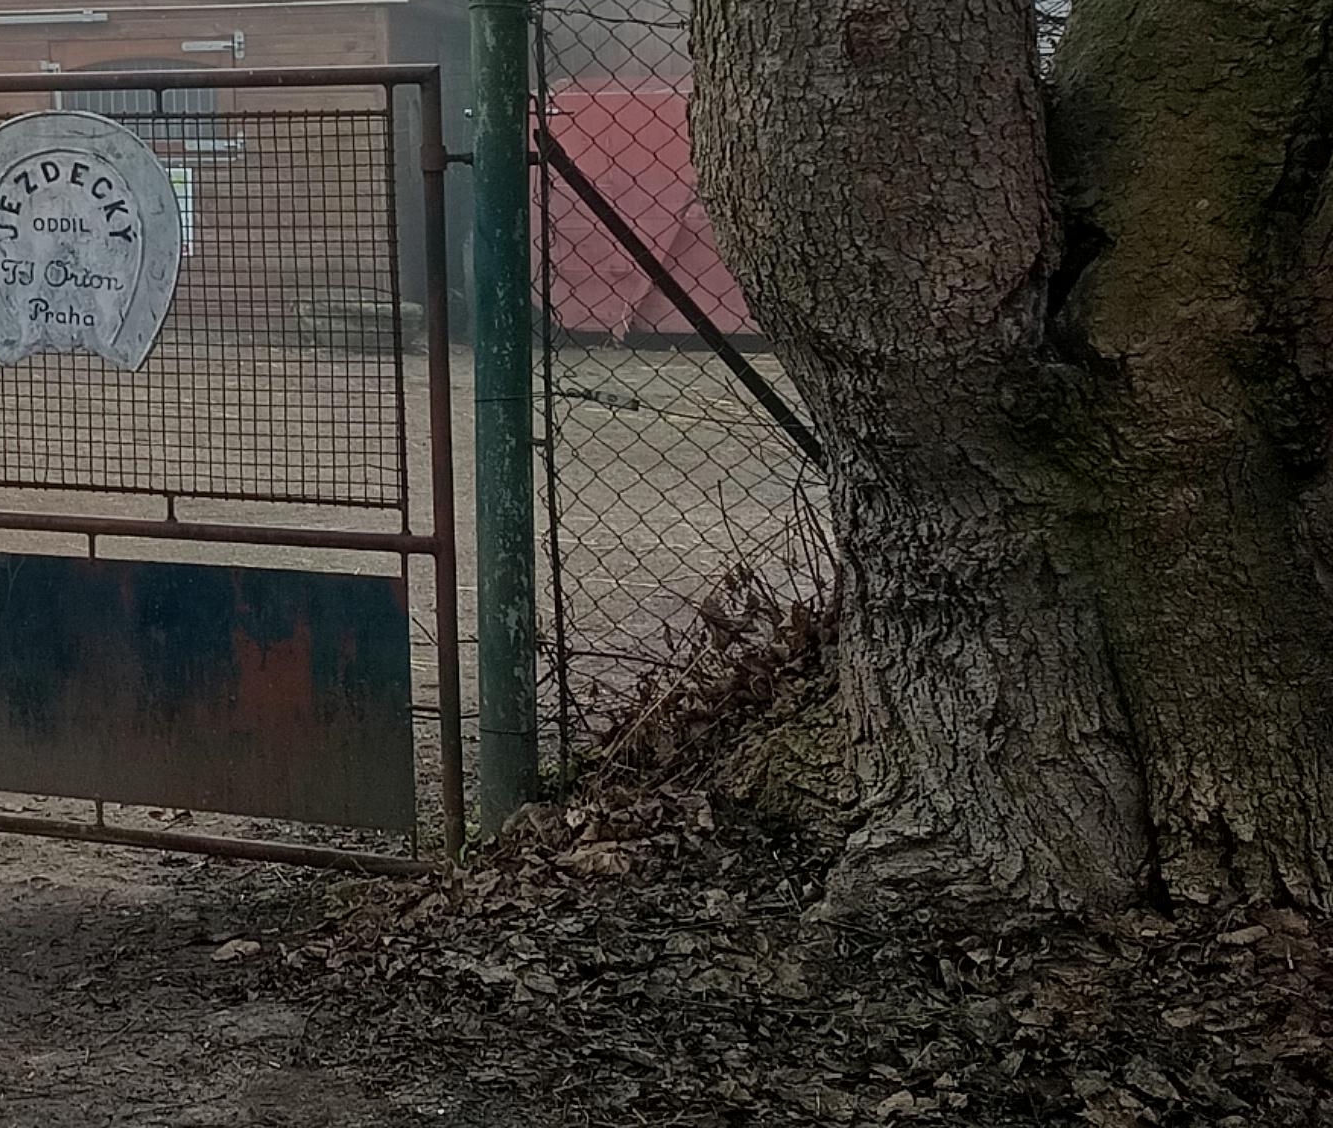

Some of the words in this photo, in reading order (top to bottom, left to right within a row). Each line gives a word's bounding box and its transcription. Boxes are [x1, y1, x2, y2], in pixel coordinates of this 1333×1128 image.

[1, 258, 35, 286] TJ
[43, 259, 125, 291] Orion
[28, 298, 96, 327] Praha
